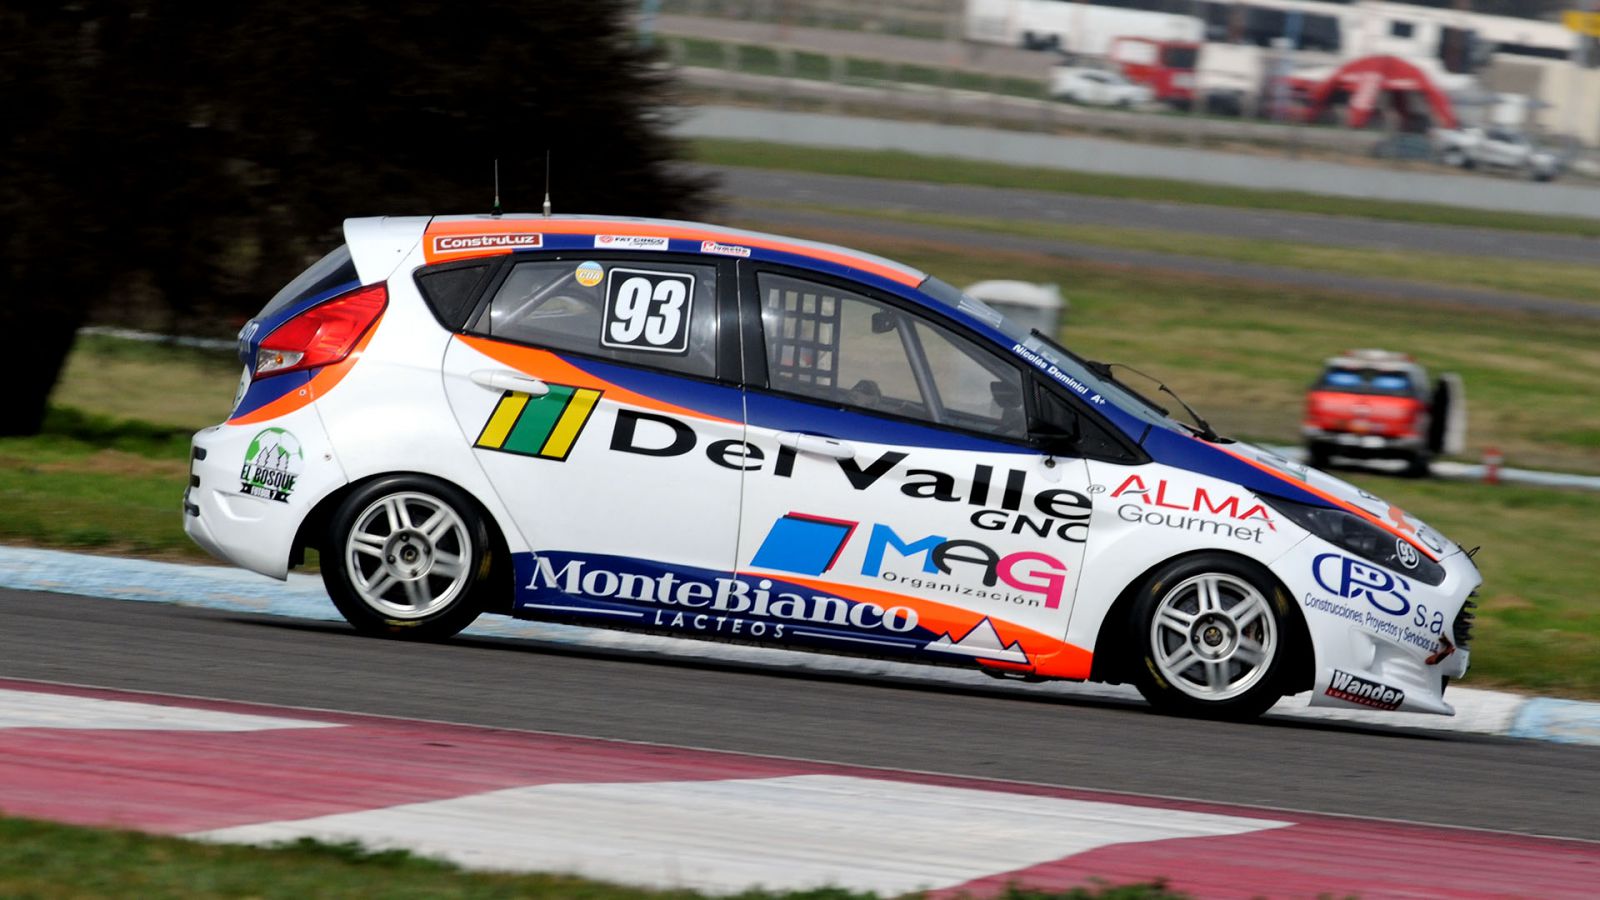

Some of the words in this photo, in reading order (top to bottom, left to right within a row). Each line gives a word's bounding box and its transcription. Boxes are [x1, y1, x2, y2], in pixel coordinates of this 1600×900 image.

[440, 235, 535, 249] ConstruLuz
[609, 277, 687, 346] 93
[240, 464, 252, 481] EL
[252, 467, 297, 491] BOSQUE
[1110, 474, 1278, 533] ALMA
[1117, 503, 1265, 544] Gourmet
[861, 523, 1068, 610] MAG
[524, 556, 920, 633] MonteBianco
[882, 570, 1040, 608] Organización
[655, 612, 785, 639] LACTEOS
[1332, 670, 1405, 704] Wander
